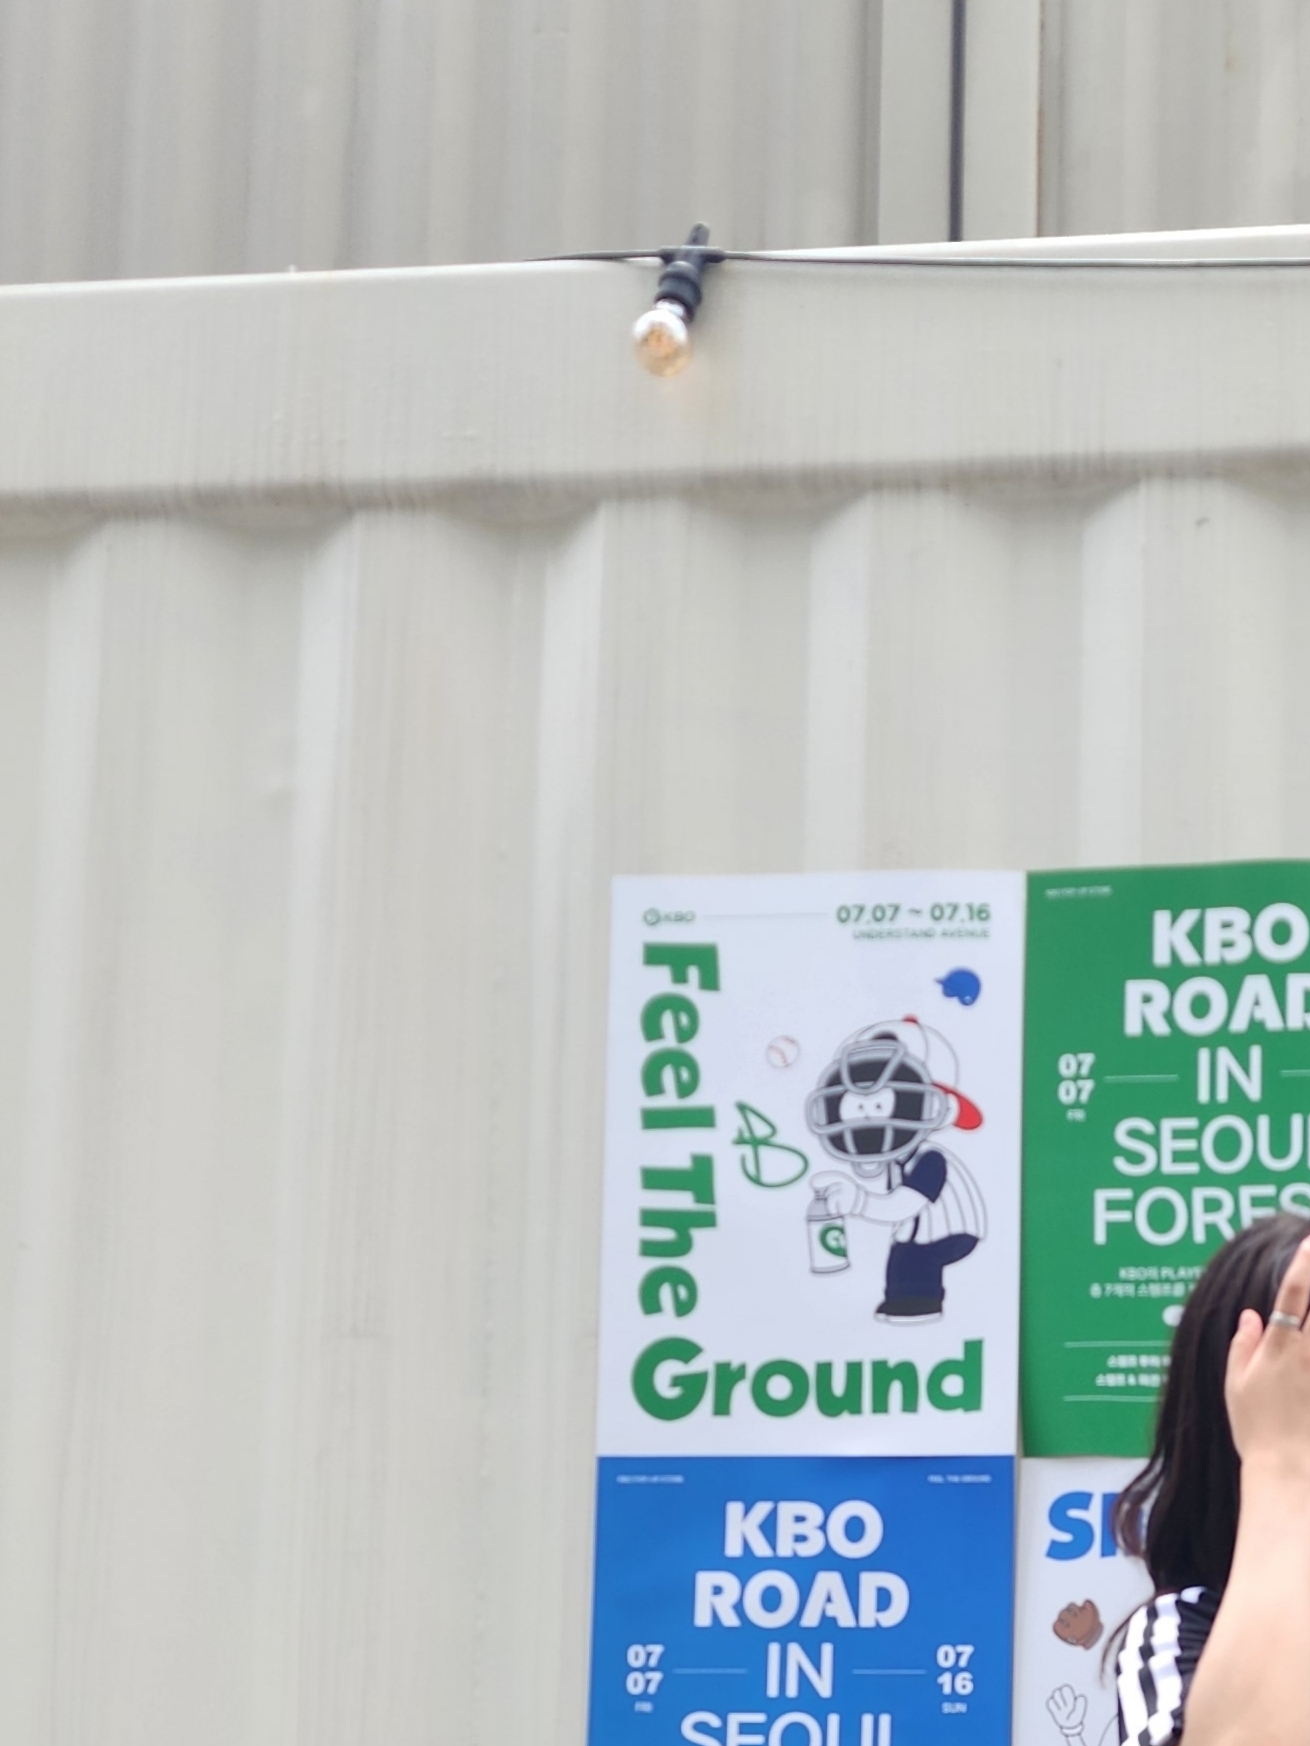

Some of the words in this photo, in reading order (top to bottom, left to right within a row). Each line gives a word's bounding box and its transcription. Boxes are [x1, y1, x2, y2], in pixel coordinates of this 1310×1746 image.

[837, 904, 900, 924] 07.07
[930, 903, 990, 922] 07.16
[1153, 903, 1309, 966] KBO
[641, 943, 720, 1130] Feel
[1059, 1053, 1095, 1080] 07
[1198, 1045, 1262, 1103] IN
[1058, 1079, 1094, 1104] 07
[639, 1154, 717, 1317] The
[631, 1337, 983, 1421] Ground
[725, 1500, 883, 1558] KBO
[694, 1570, 909, 1628] ROAD
[627, 1645, 664, 1667] 07
[767, 1643, 833, 1698] IN
[937, 1645, 974, 1667] 07
[627, 1671, 663, 1695] 07
[937, 1672, 973, 1695] 16
[942, 1702, 967, 1713] SUN
